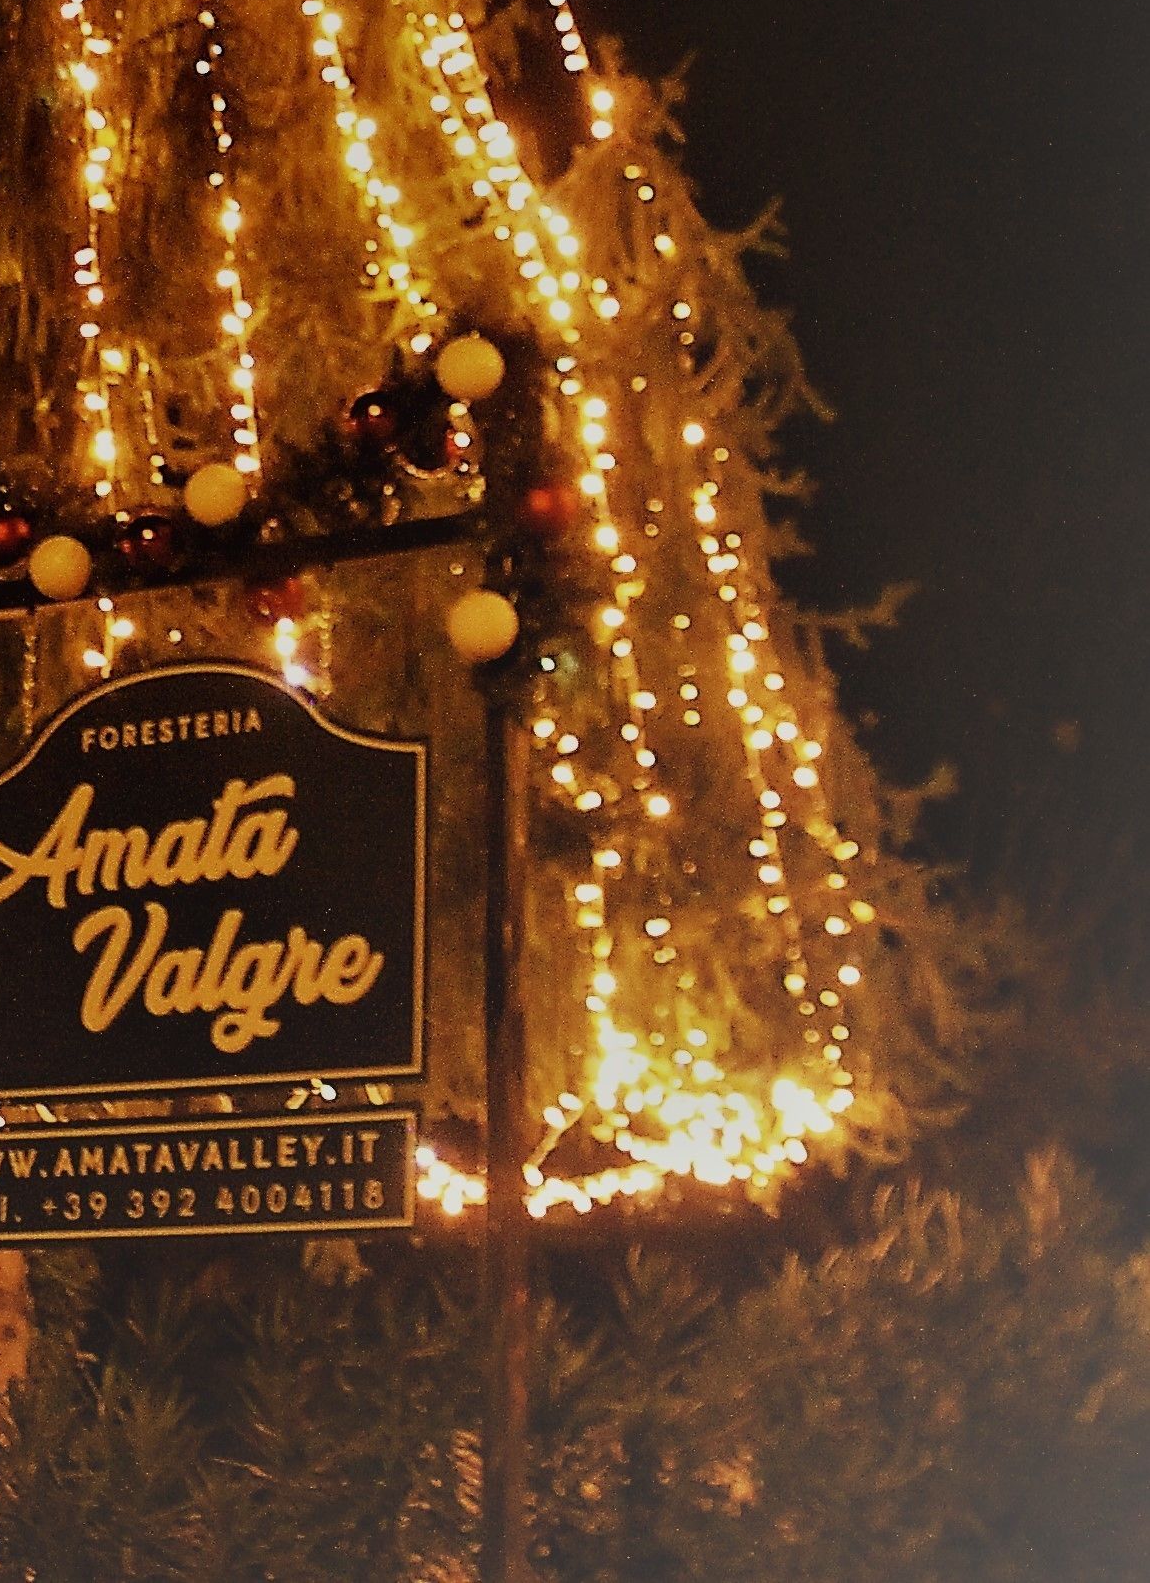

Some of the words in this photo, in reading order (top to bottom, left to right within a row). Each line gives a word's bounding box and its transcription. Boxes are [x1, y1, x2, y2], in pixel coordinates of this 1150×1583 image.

[81, 708, 262, 753] FORESTERIA
[72, 901, 385, 1054] Valgre
[42, 1191, 107, 1221] +39
[126, 1187, 196, 1219] 392
